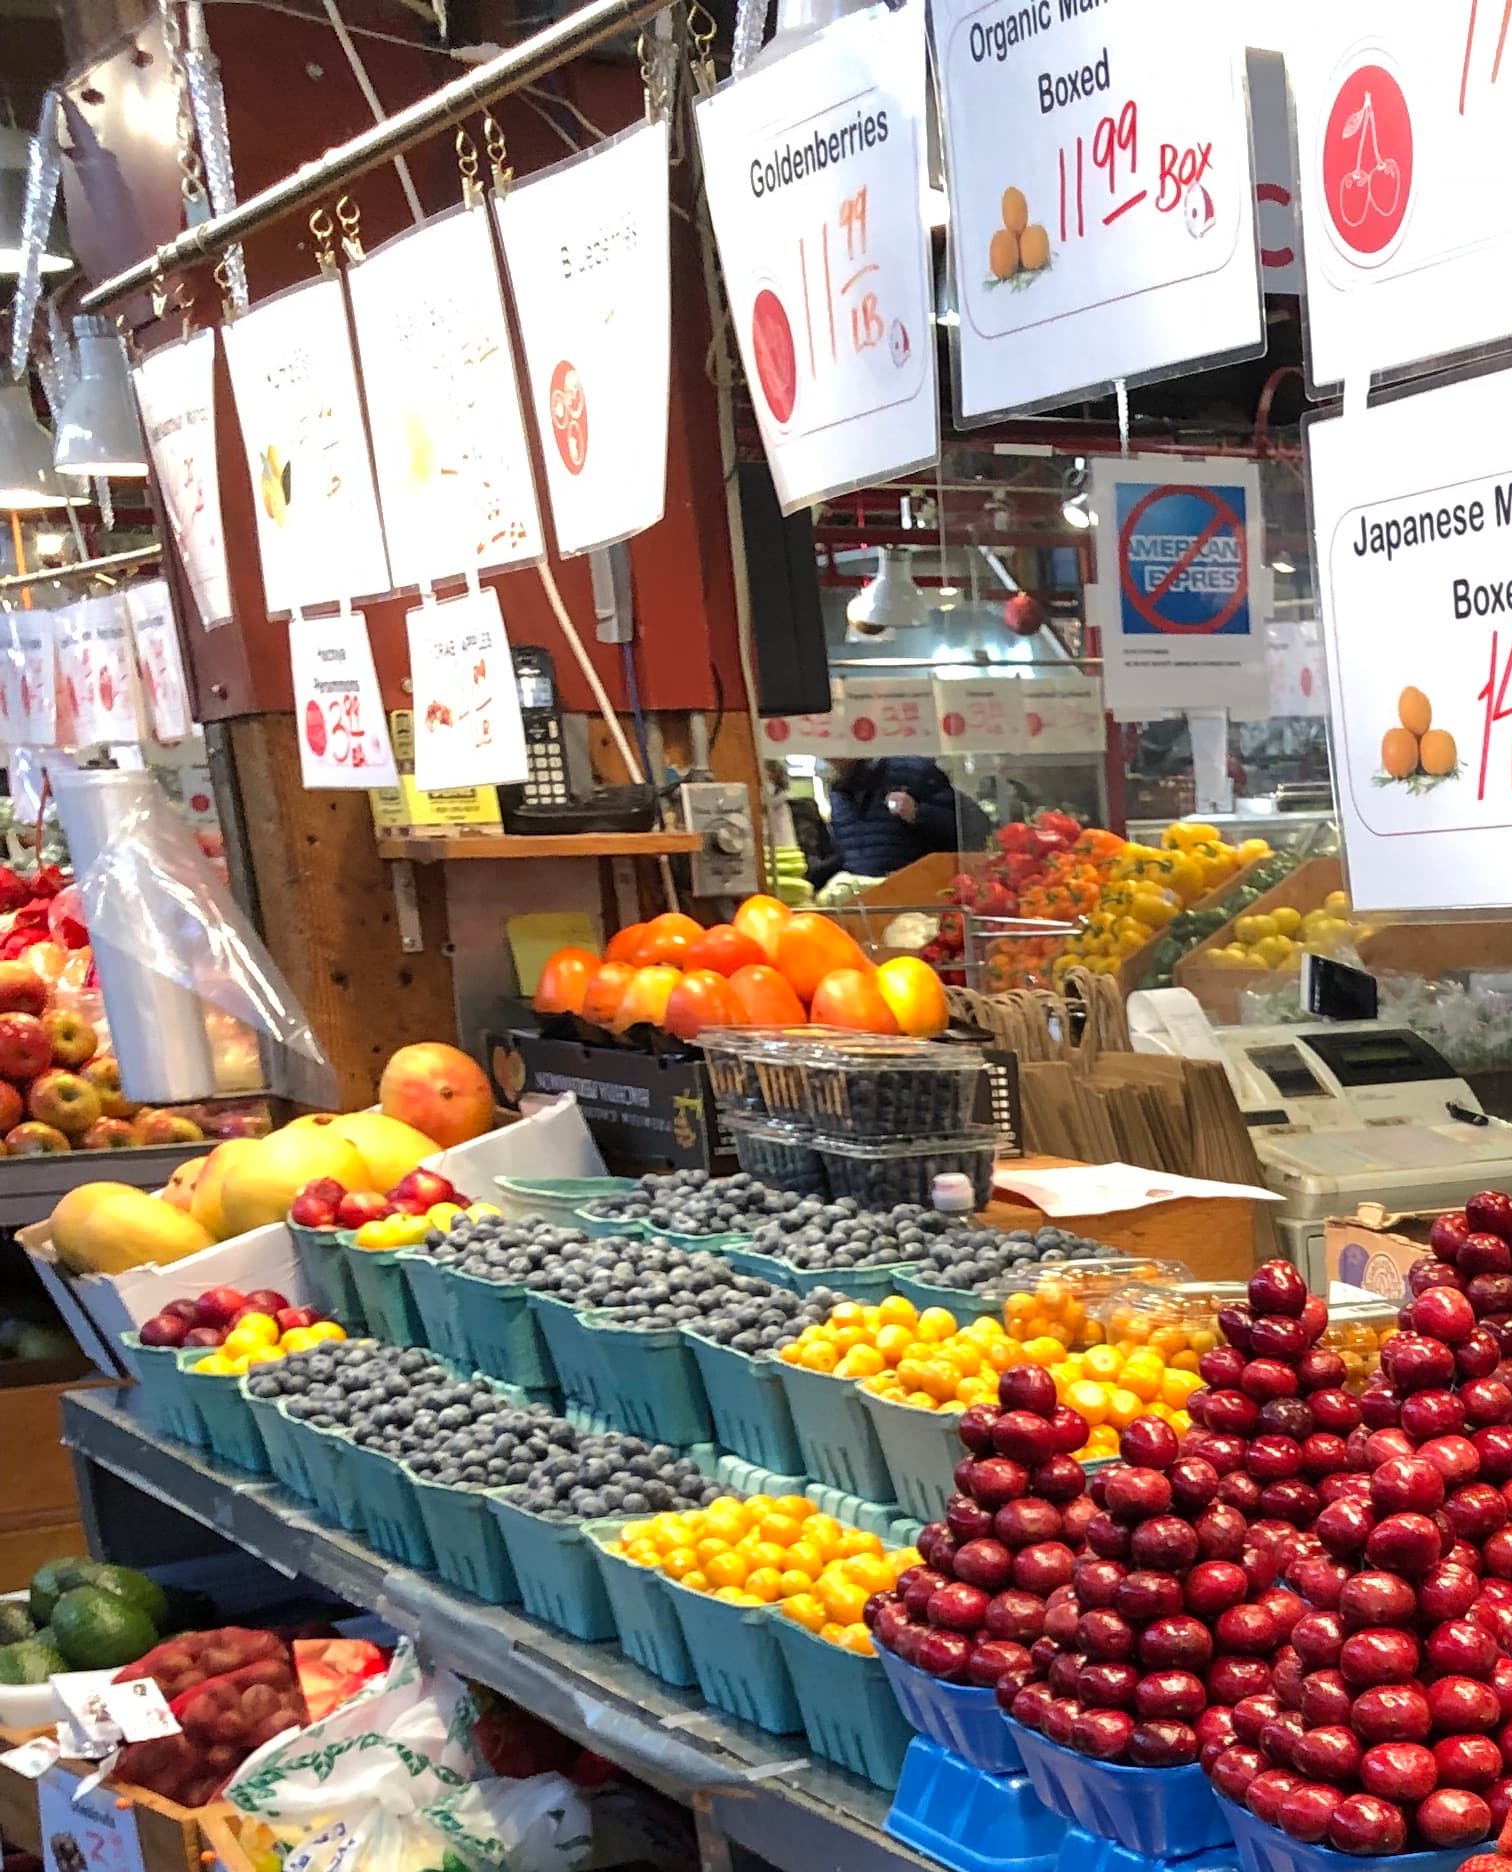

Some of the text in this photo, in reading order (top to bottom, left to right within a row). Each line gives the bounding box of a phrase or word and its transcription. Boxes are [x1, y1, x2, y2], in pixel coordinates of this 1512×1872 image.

[970, 0, 1052, 62] Organic
[1038, 47, 1110, 114] Boxed
[750, 110, 889, 198] Goldenberries
[852, 292, 885, 353] LB
[1127, 538, 1241, 560] AMERAN
[1353, 500, 1485, 561] Japanese
[1151, 568, 1241, 589] EPRES
